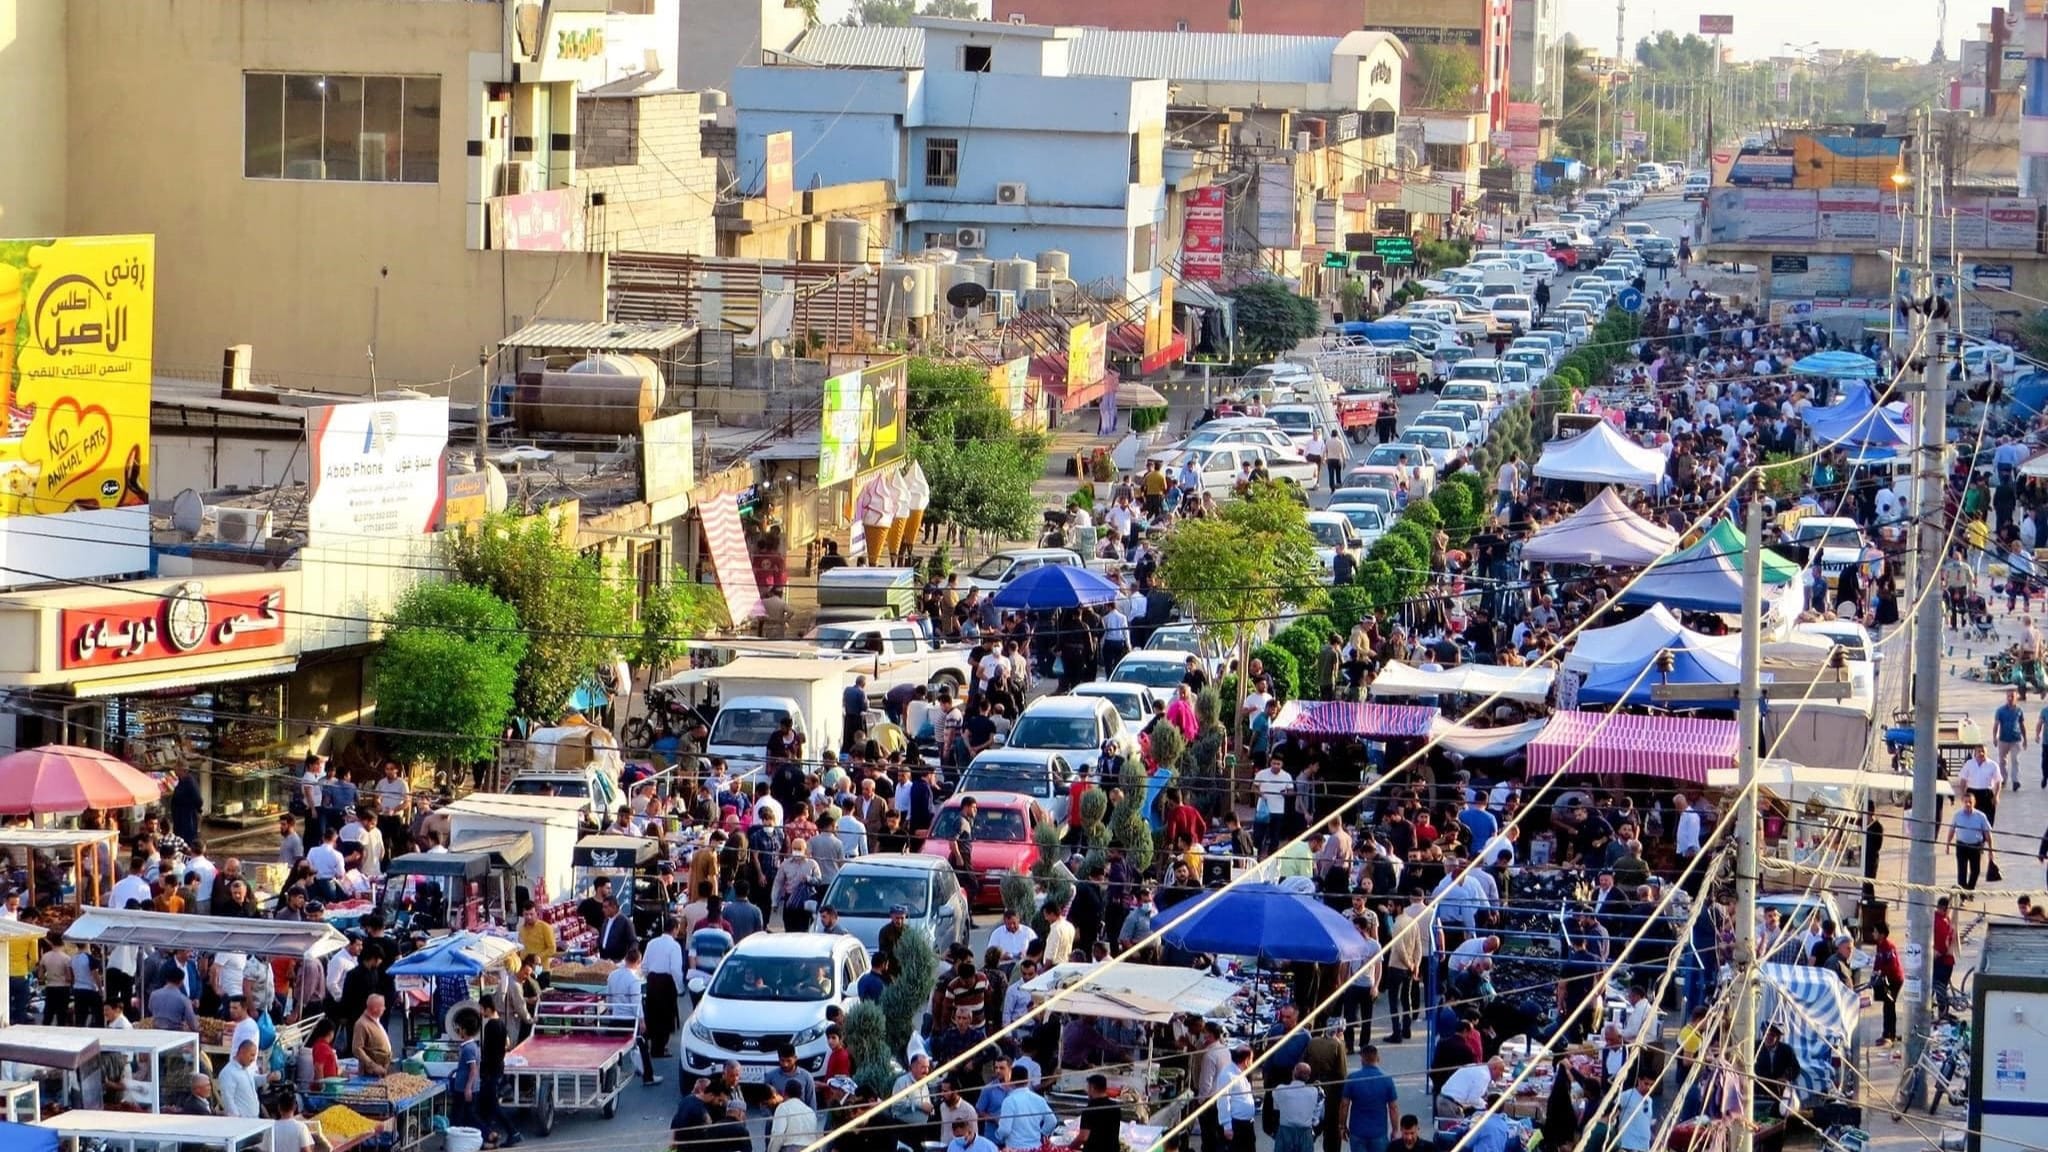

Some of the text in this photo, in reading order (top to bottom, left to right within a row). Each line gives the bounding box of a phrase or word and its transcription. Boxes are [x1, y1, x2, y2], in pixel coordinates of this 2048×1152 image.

[50, 287, 92, 318] أطلس
[44, 291, 128, 356] الأصيل
[47, 426, 106, 493] ANIMAL FATS
[48, 428, 69, 461] NO
[326, 460, 384, 479] Abdo Phone
[742, 1039, 760, 1048] KIA
